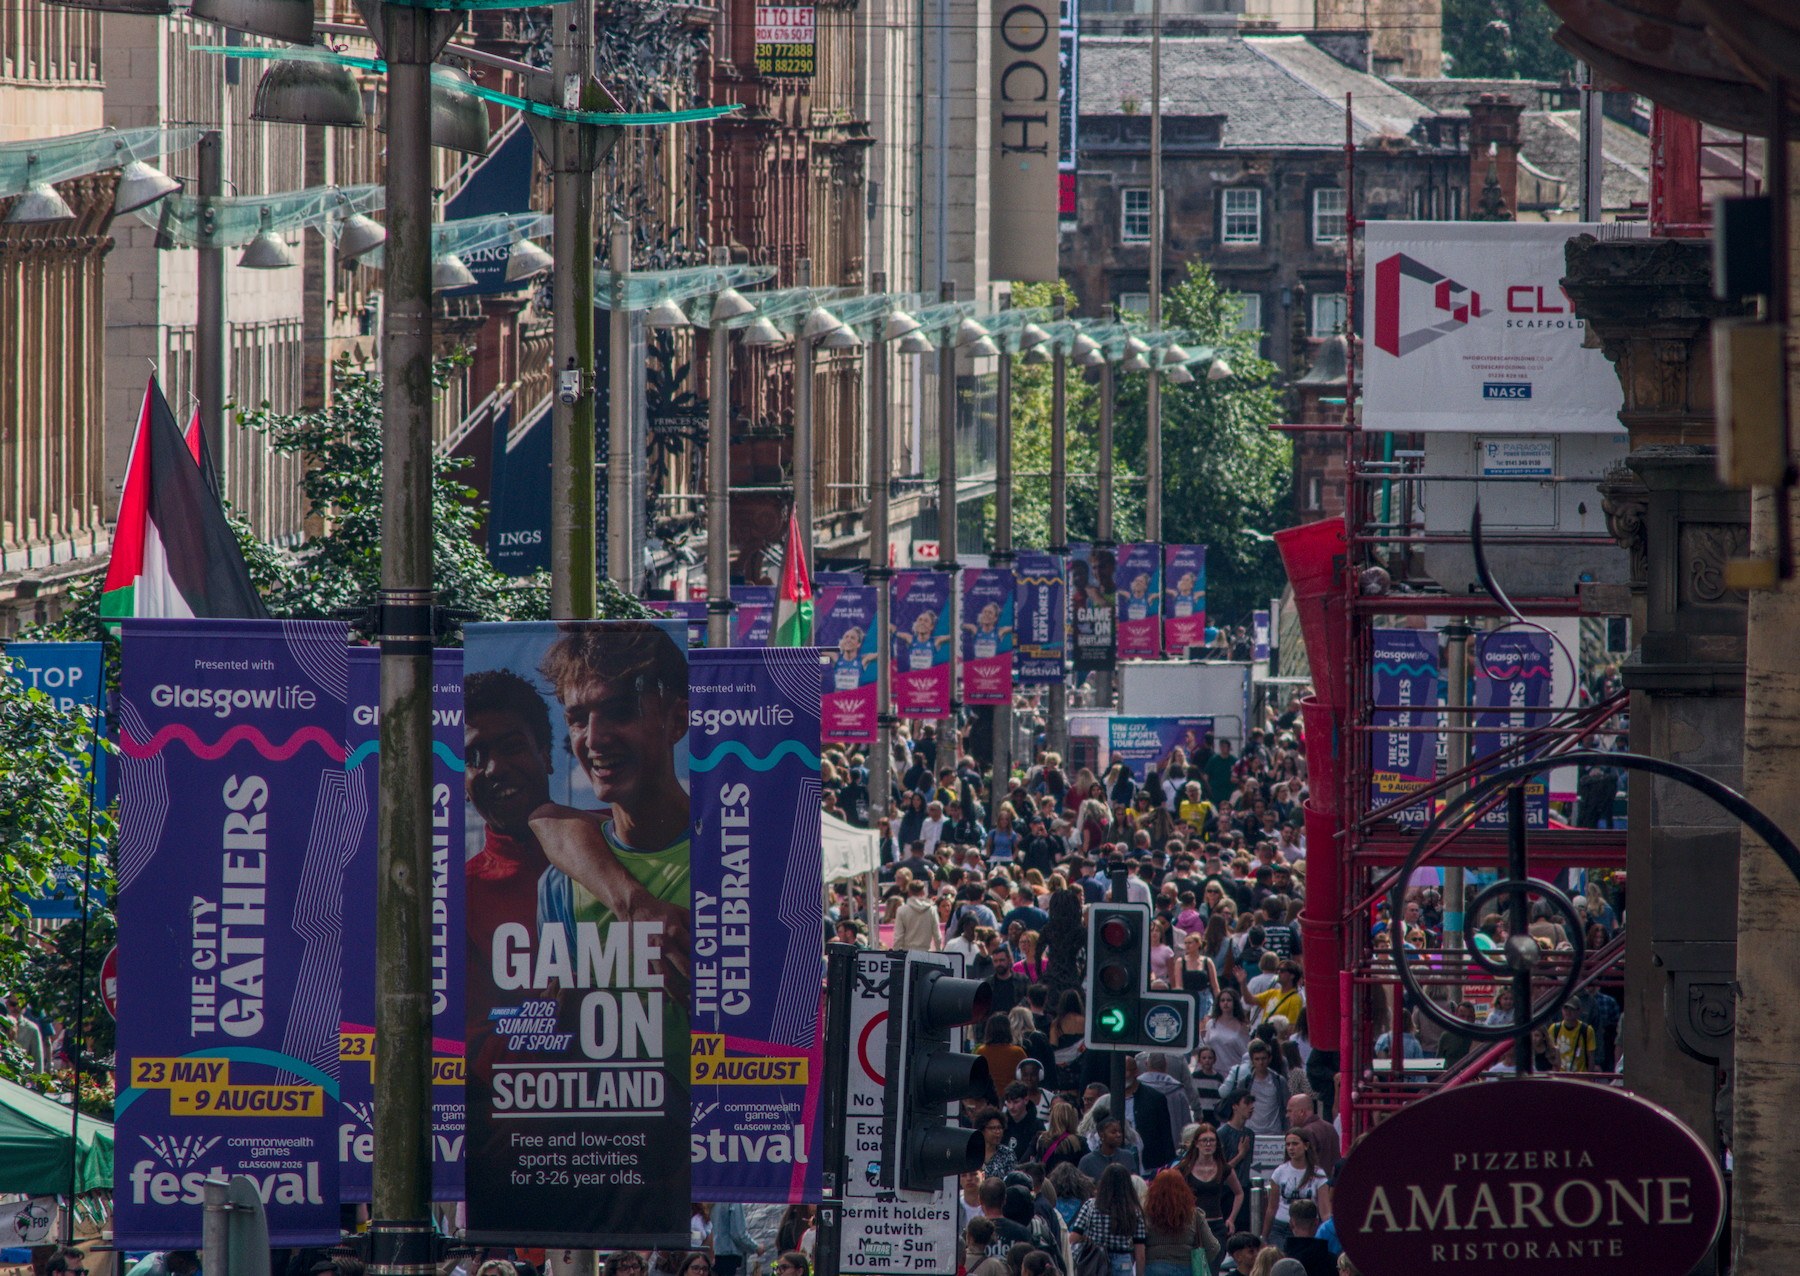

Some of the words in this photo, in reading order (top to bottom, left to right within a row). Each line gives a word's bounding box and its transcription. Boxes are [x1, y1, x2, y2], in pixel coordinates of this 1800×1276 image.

[773, 8, 788, 26] TO
[793, 8, 813, 26] LET
[463, 246, 509, 268] AING
[1507, 319, 1584, 329] SCAFFOLD
[1489, 387, 1526, 397] NASC
[1077, 607, 1112, 621] GAME
[1095, 621, 1111, 635] ON
[194, 659, 248, 670] Presented
[252, 659, 275, 670] with
[1021, 666, 1061, 675] festival
[28, 667, 83, 687] TOP
[441, 684, 461, 693] with
[736, 683, 756, 693] with
[151, 684, 316, 718] Glasgowlife
[689, 704, 794, 735] sgowlife
[219, 774, 269, 1038] GATHERS
[720, 783, 750, 1015] CELEBRATES
[695, 890, 718, 956] CITY
[191, 896, 217, 970] CITY
[492, 921, 664, 990] GAME
[695, 961, 717, 1016] THE
[191, 976, 216, 1037] THE
[519, 1001, 556, 1017] 2026
[496, 1018, 556, 1034] SUMMER
[580, 991, 663, 1060] ON
[340, 1038, 365, 1055] 23
[508, 1034, 527, 1050] OF
[527, 1034, 572, 1050] SPORT
[691, 1038, 720, 1055] AY
[137, 1062, 165, 1082] 23
[170, 1062, 224, 1083] MAY
[695, 1062, 709, 1080] 9
[712, 1062, 801, 1080] AUGUST
[492, 1071, 665, 1110] SCOTLAND
[195, 1090, 210, 1111] 9
[214, 1090, 314, 1111] AUGUST
[724, 1103, 800, 1112] commonwealth
[854, 1094, 874, 1106] No
[745, 1112, 779, 1122] games
[227, 1137, 314, 1148] commonwealth
[511, 1133, 544, 1147] Free
[548, 1132, 576, 1147] and
[581, 1132, 646, 1147] low-cost
[690, 1123, 809, 1163] stival
[250, 1147, 290, 1159] games
[518, 1153, 567, 1169] sports
[571, 1151, 638, 1166] activities
[1454, 1150, 1594, 1171] PIZZERIA
[238, 1161, 281, 1169] GLASGOW
[281, 1161, 303, 1169] 2026
[510, 1170, 531, 1185] for
[535, 1171, 569, 1185] 3-26
[573, 1173, 605, 1188] year
[610, 1170, 645, 1184] olds.
[894, 1206, 950, 1220] holders
[1359, 1177, 1694, 1232] AMARONE
[33, 1217, 49, 1228] FOP
[865, 1224, 923, 1235] outwith
[903, 1239, 933, 1252] Sun
[1432, 1239, 1624, 1262] RISTORANTE
[848, 1253, 865, 1266] 10
[869, 1256, 890, 1267] am
[903, 1255, 911, 1267] 7
[914, 1257, 936, 1270] pm
